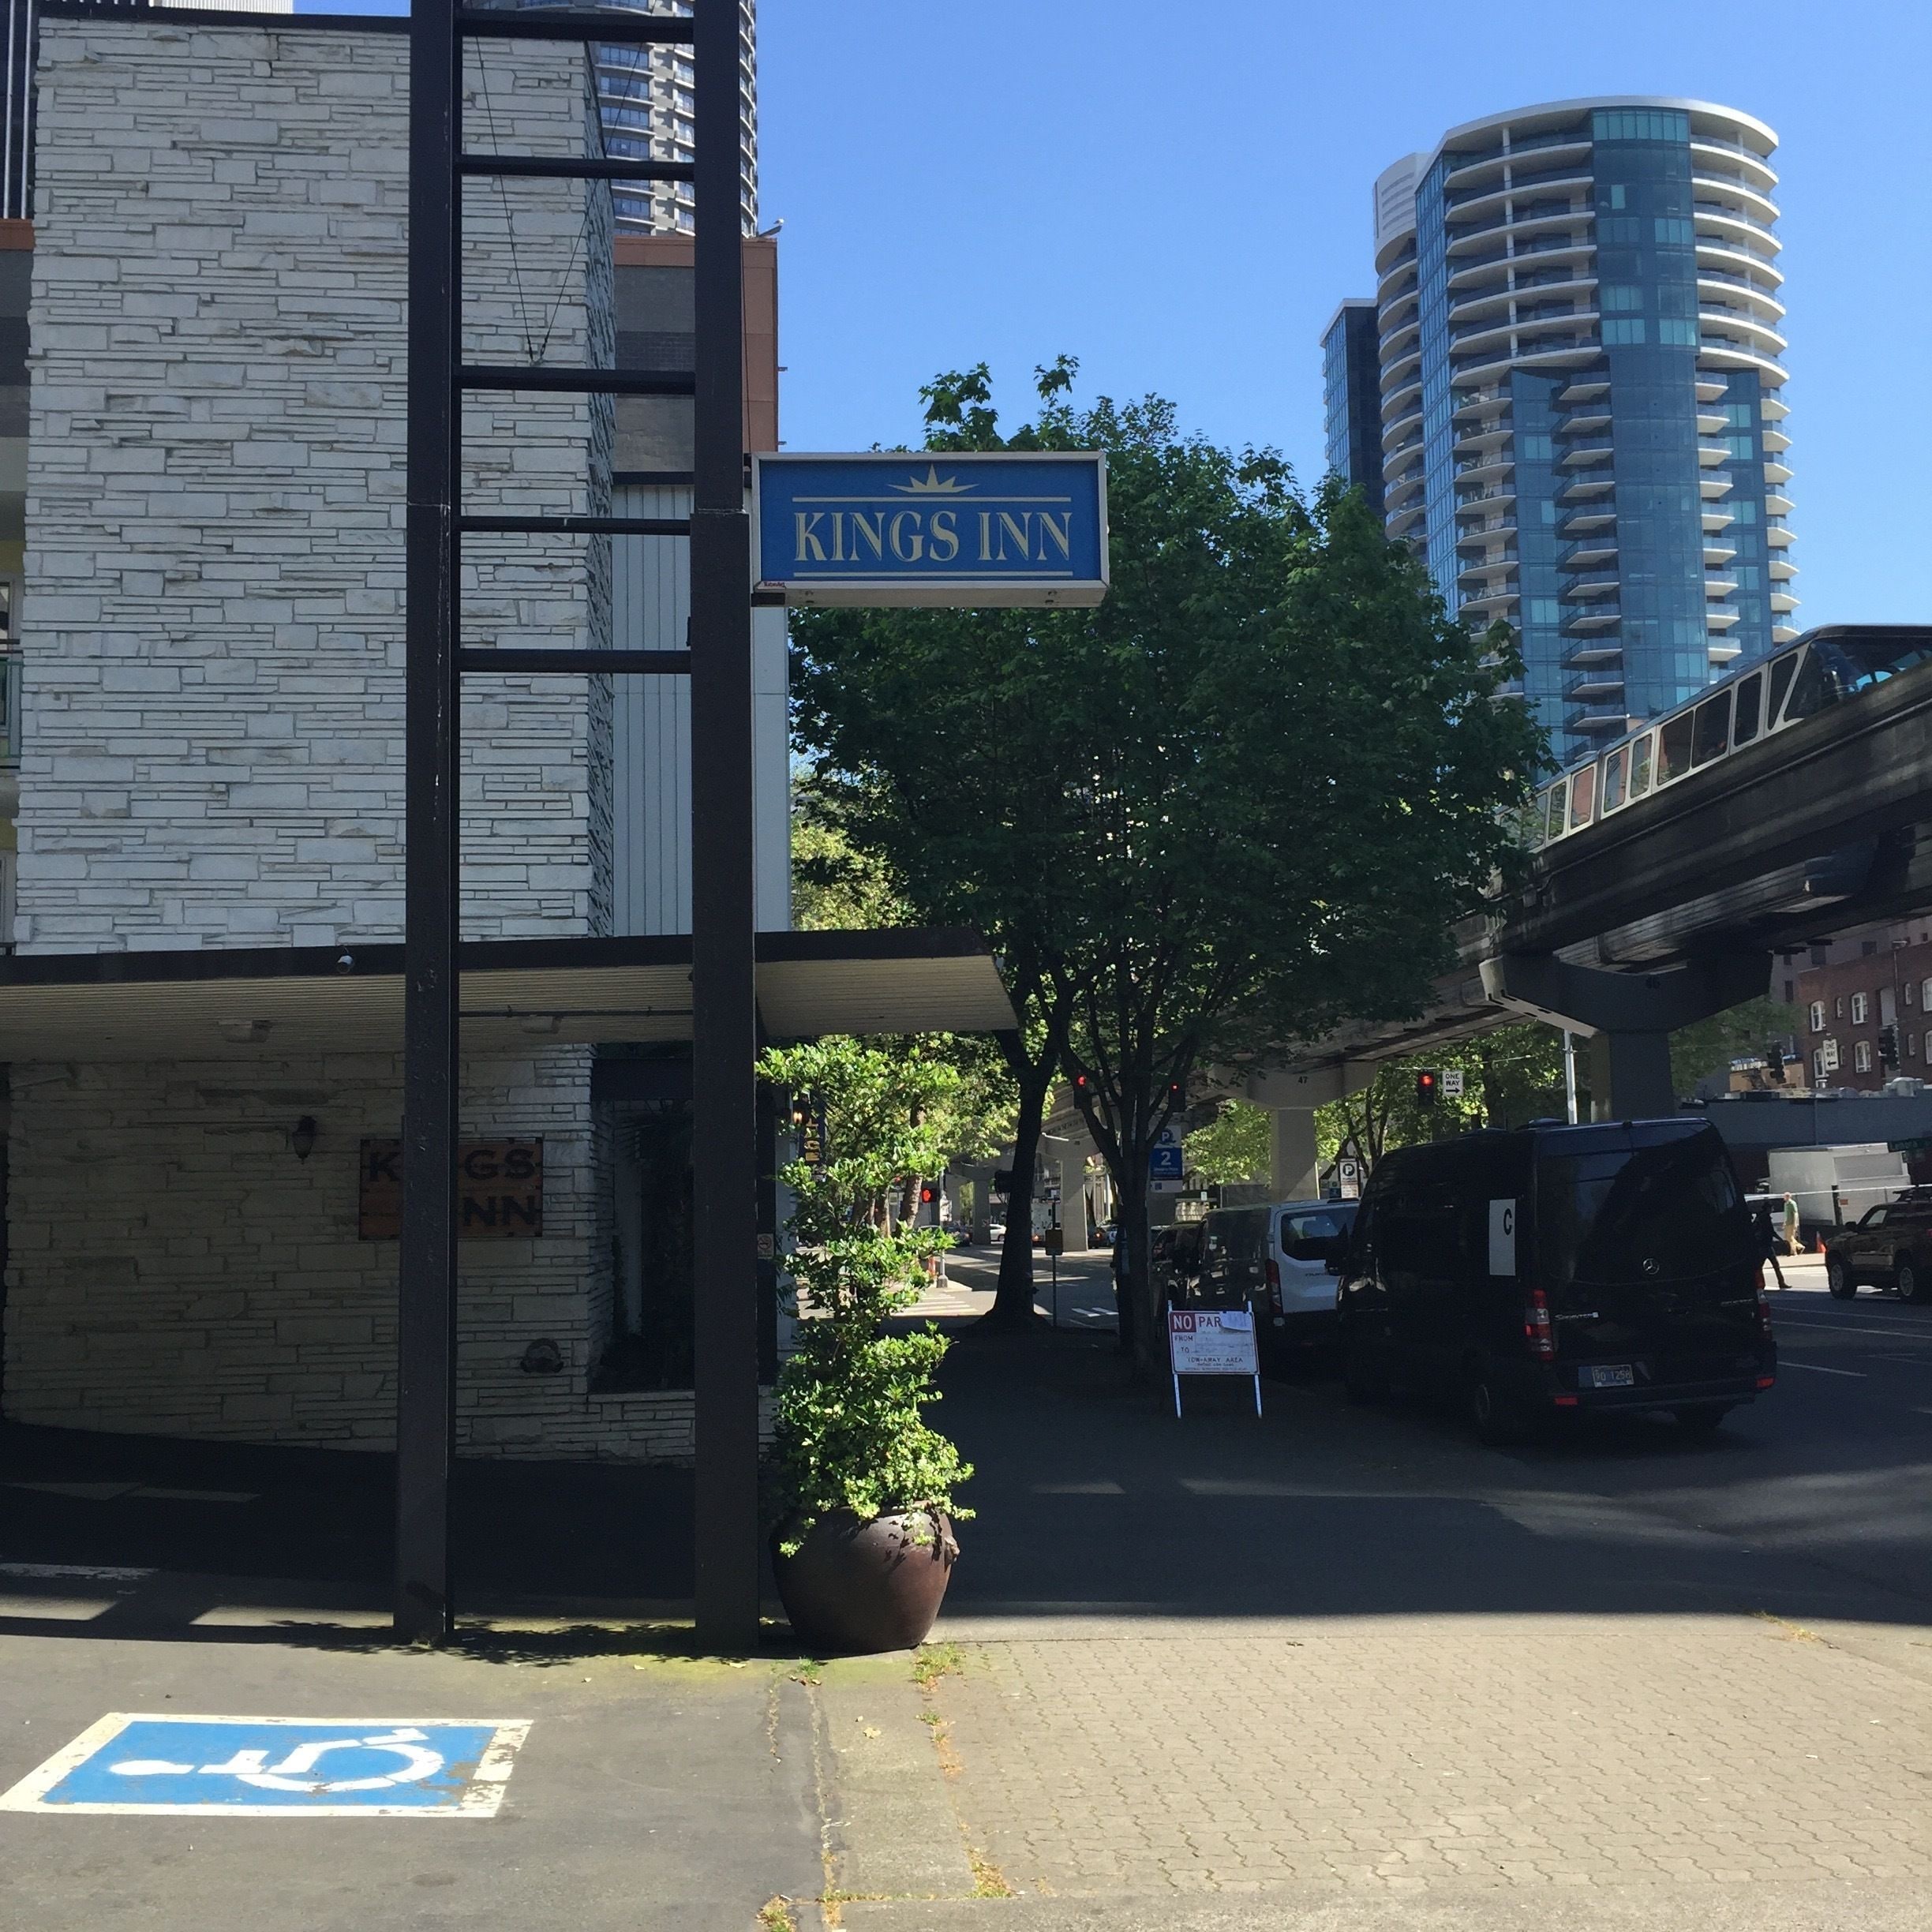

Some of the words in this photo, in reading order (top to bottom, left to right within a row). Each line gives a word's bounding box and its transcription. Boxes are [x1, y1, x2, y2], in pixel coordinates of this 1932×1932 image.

[794, 511, 959, 562] KINGS
[978, 511, 1073, 561] INN
[369, 1148, 535, 1182] KGS
[1160, 1151, 1172, 1166] 2
[1503, 1208, 1512, 1235] C
[1173, 1315, 1193, 1330] NO
